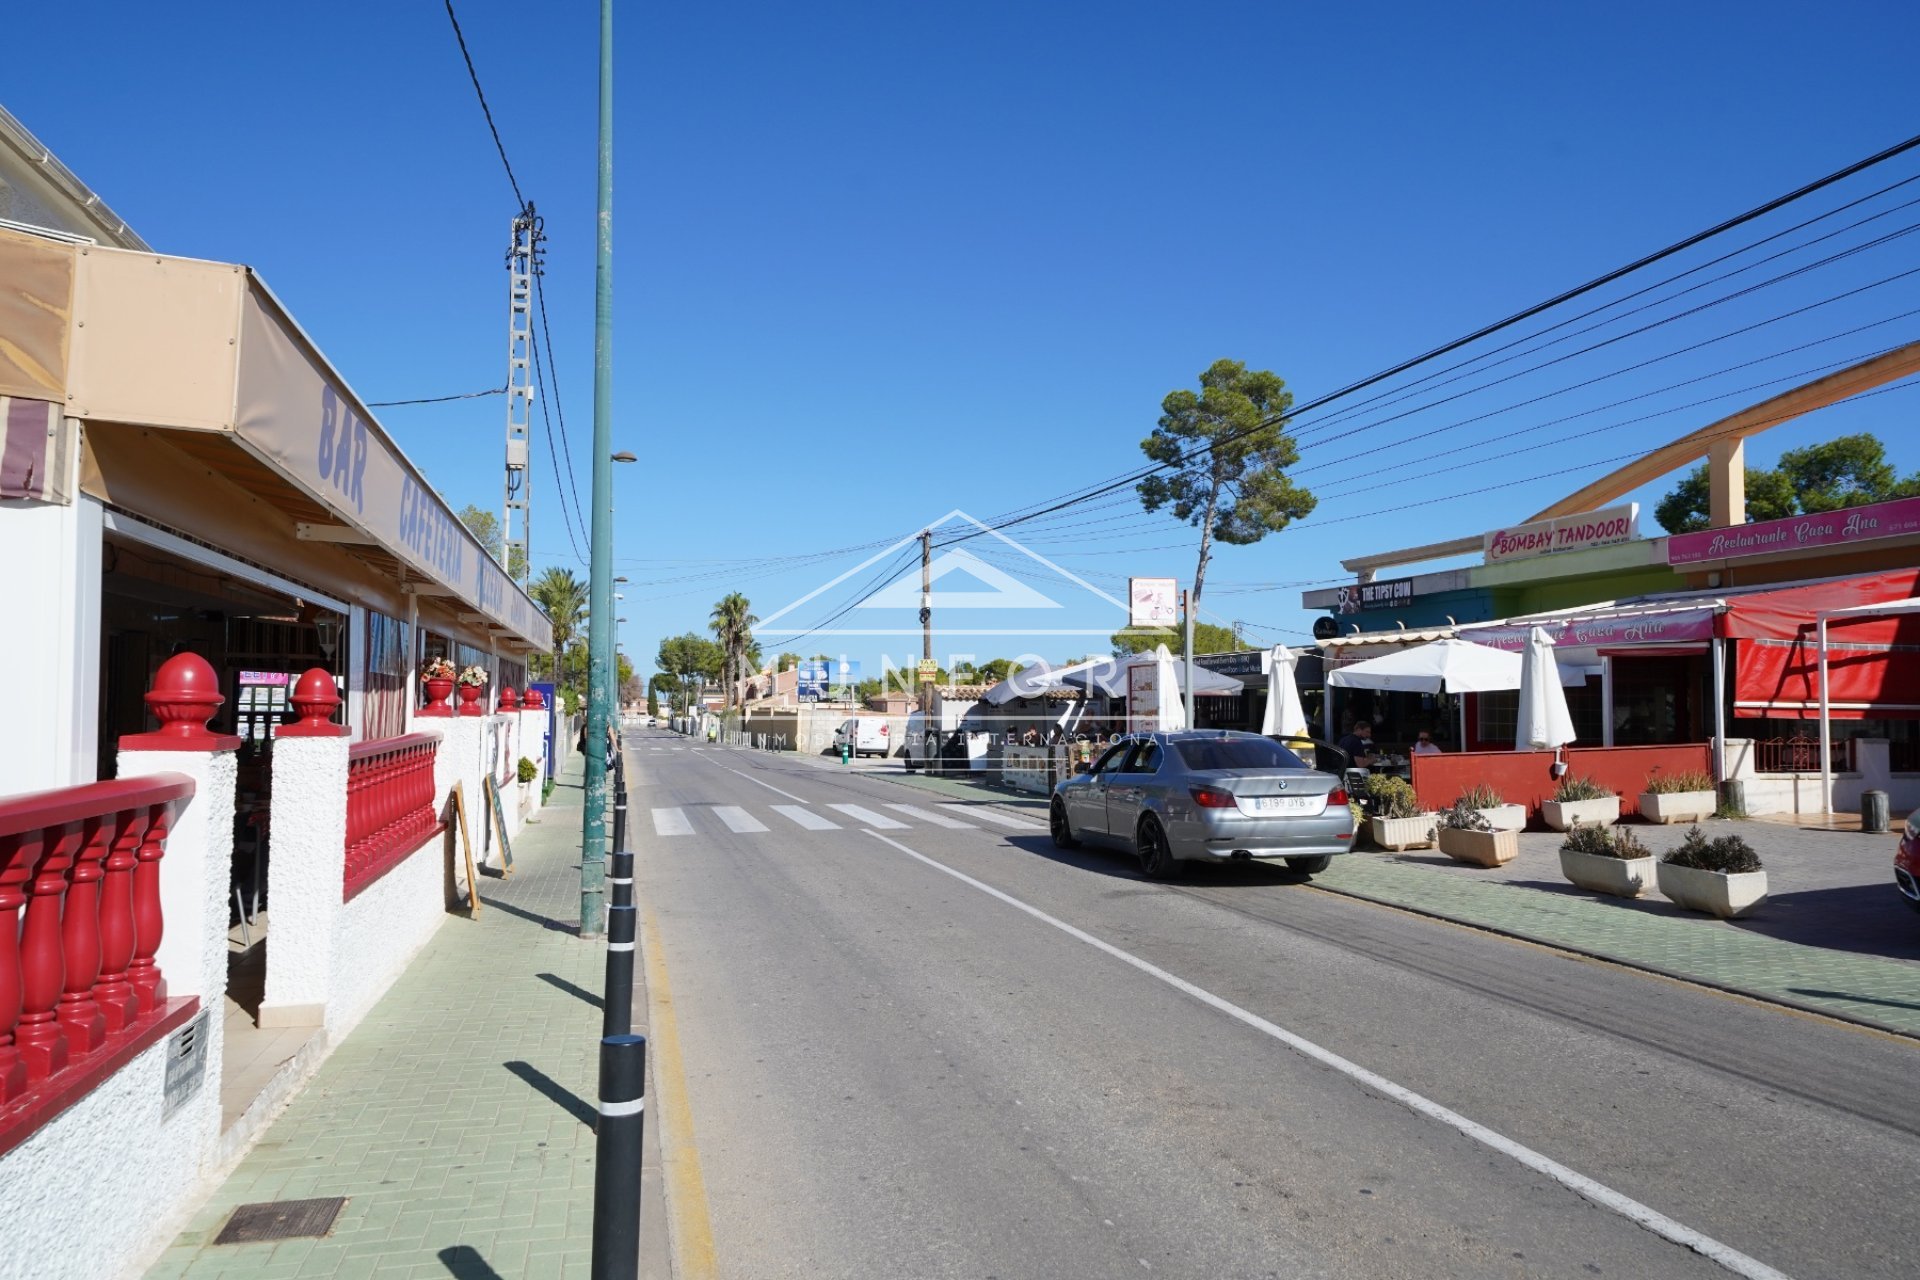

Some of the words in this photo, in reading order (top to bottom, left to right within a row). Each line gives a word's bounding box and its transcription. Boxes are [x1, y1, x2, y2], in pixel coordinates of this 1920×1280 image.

[318, 383, 367, 515] BAR
[400, 474, 462, 584] CAFETERIA
[1500, 531, 1554, 555] BOMBAY
[1558, 518, 1630, 544] TANDOORI
[1709, 526, 1787, 555] Restaurante
[1794, 522, 1833, 543] Casa
[1841, 513, 1878, 537] Ana
[1362, 586, 1375, 601] THE
[1375, 583, 1394, 600] TIPSY
[1394, 581, 1411, 598] COW
[1576, 622, 1613, 643] Casa
[1624, 620, 1664, 640] Ana
